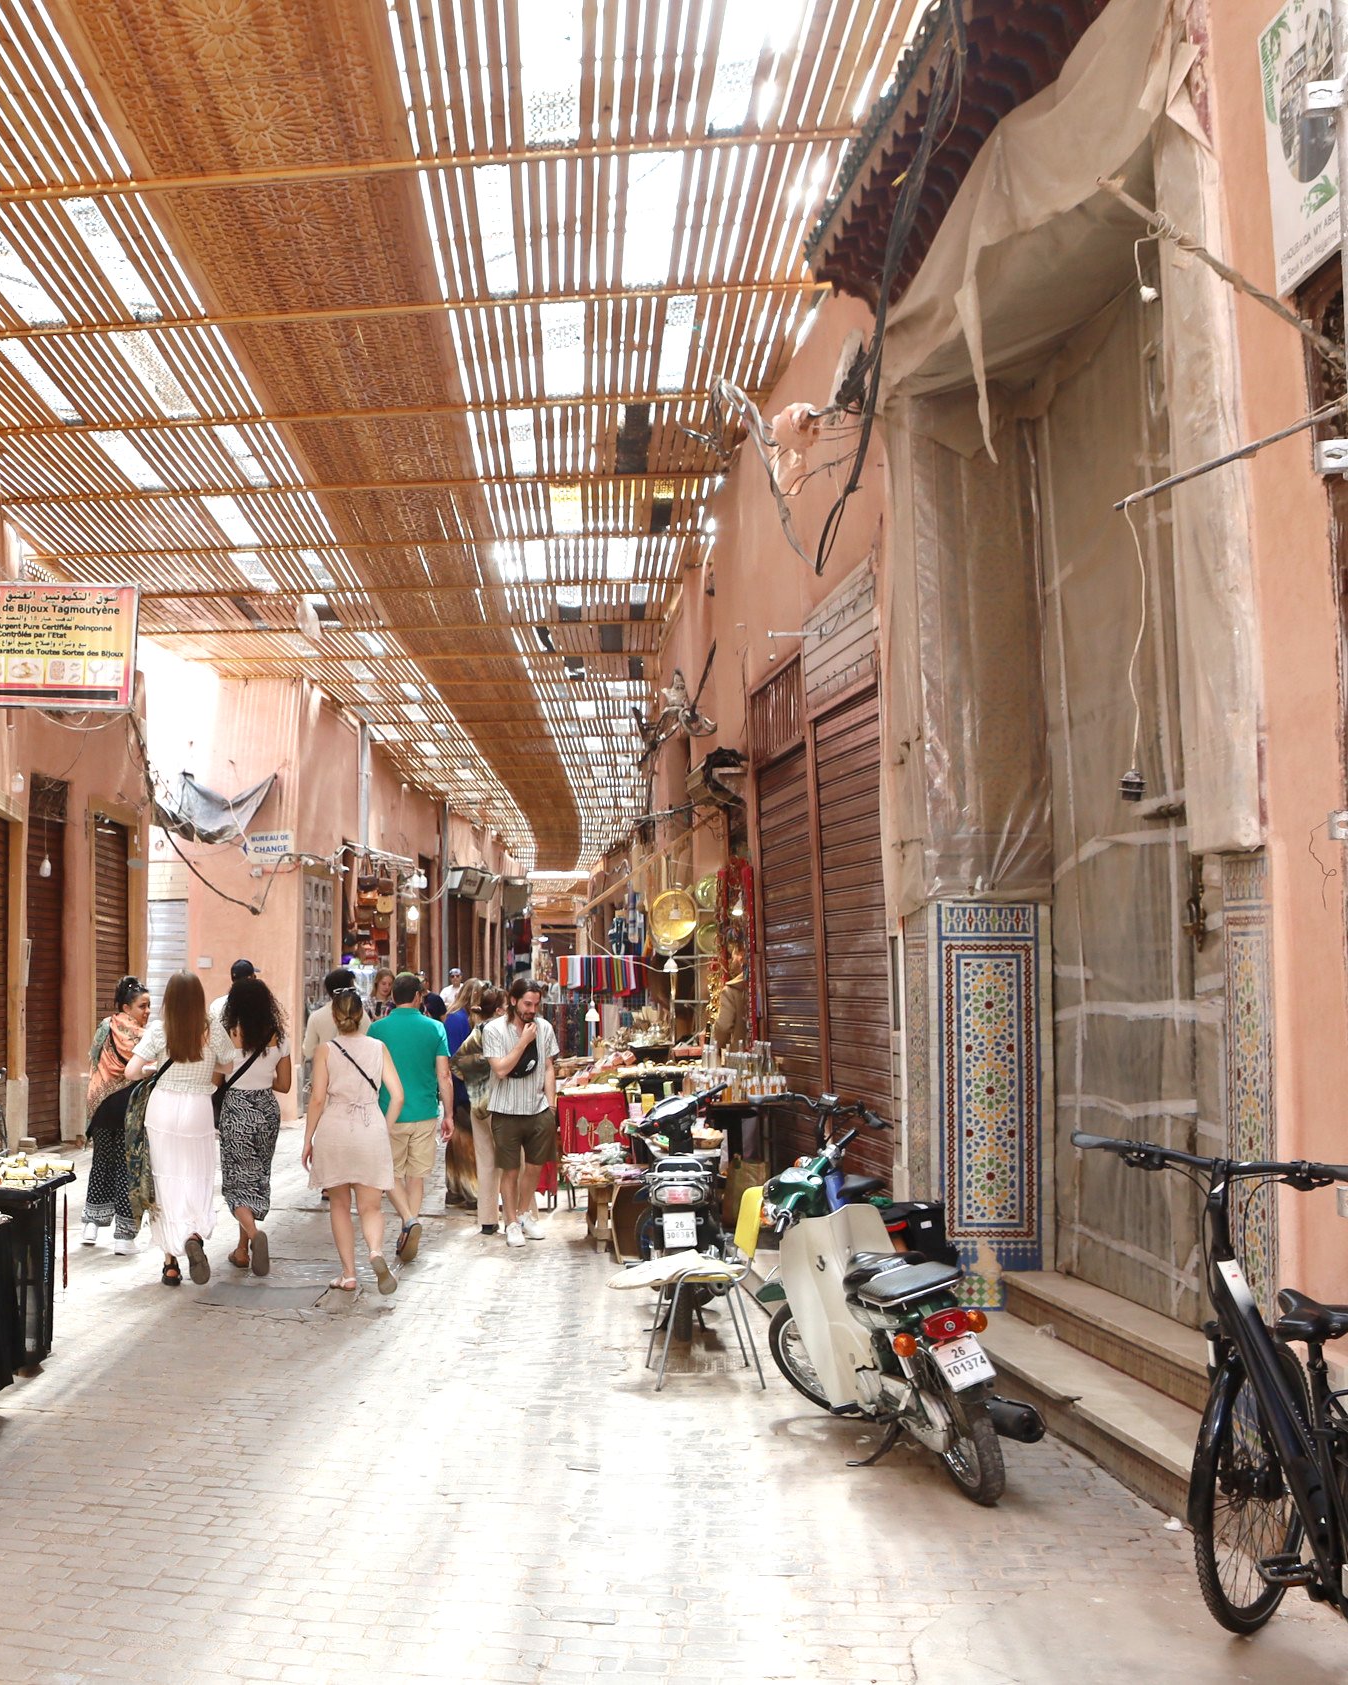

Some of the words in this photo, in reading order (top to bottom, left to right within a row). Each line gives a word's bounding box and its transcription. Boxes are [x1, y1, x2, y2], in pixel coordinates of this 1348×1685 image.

[5, 590, 36, 602] العتيق
[2, 603, 14, 612] de
[17, 604, 49, 614] Bijoux
[52, 605, 120, 616] Tagmoutyène
[42, 623, 72, 631] Certifiés
[74, 624, 112, 632] Poinçonné
[101, 650, 124, 658] Bijoux
[251, 834, 279, 842] BUREAU
[253, 844, 289, 853] CHANGE
[675, 1221, 685, 1229] 26
[951, 1346, 966, 1359] 26
[947, 1355, 987, 1378] 101374
